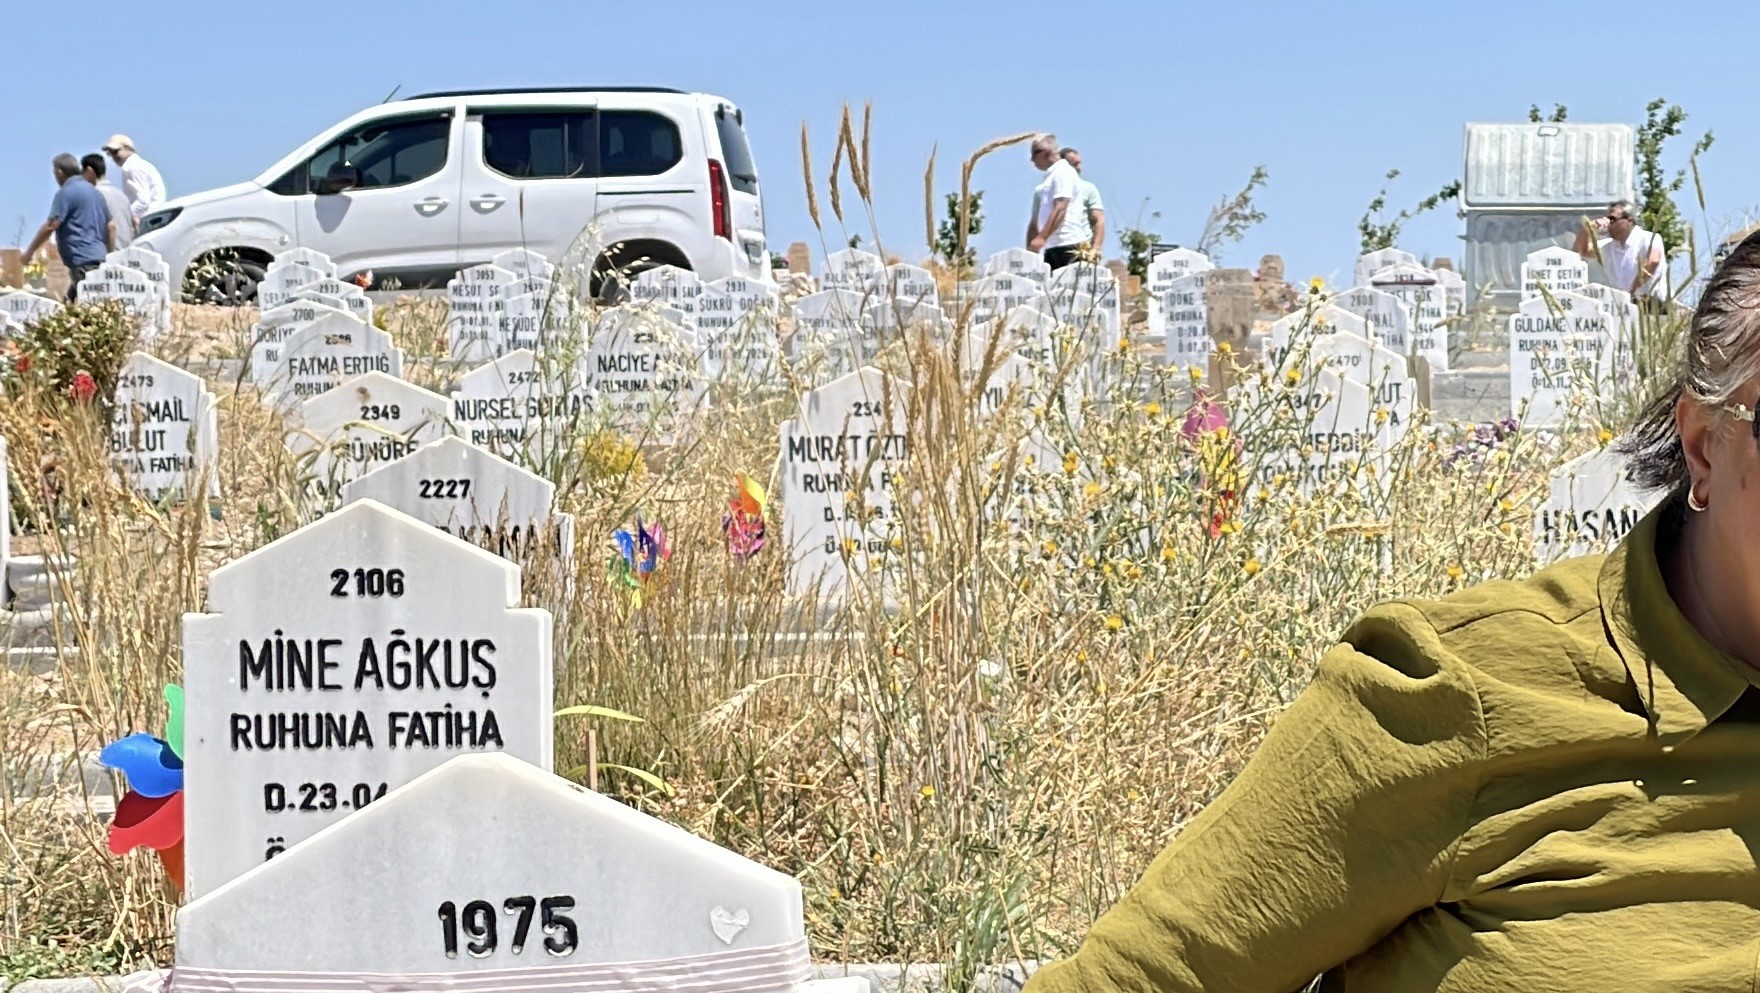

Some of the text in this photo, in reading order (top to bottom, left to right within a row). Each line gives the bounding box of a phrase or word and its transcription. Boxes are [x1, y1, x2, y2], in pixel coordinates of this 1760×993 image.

[288, 355, 340, 377] FATMA
[597, 351, 650, 374] NACİYE
[360, 404, 401, 421] 2349
[453, 398, 522, 422] NURSEL
[852, 400, 888, 418] 234
[788, 434, 862, 464] MURAT
[418, 478, 472, 500] 2227
[1542, 507, 1640, 544] HASAN
[329, 567, 406, 599] 2106
[237, 627, 498, 700] MİNE AĞKUŞ
[229, 701, 505, 752] RUHUNA FATİHA
[437, 893, 580, 960] 1975
